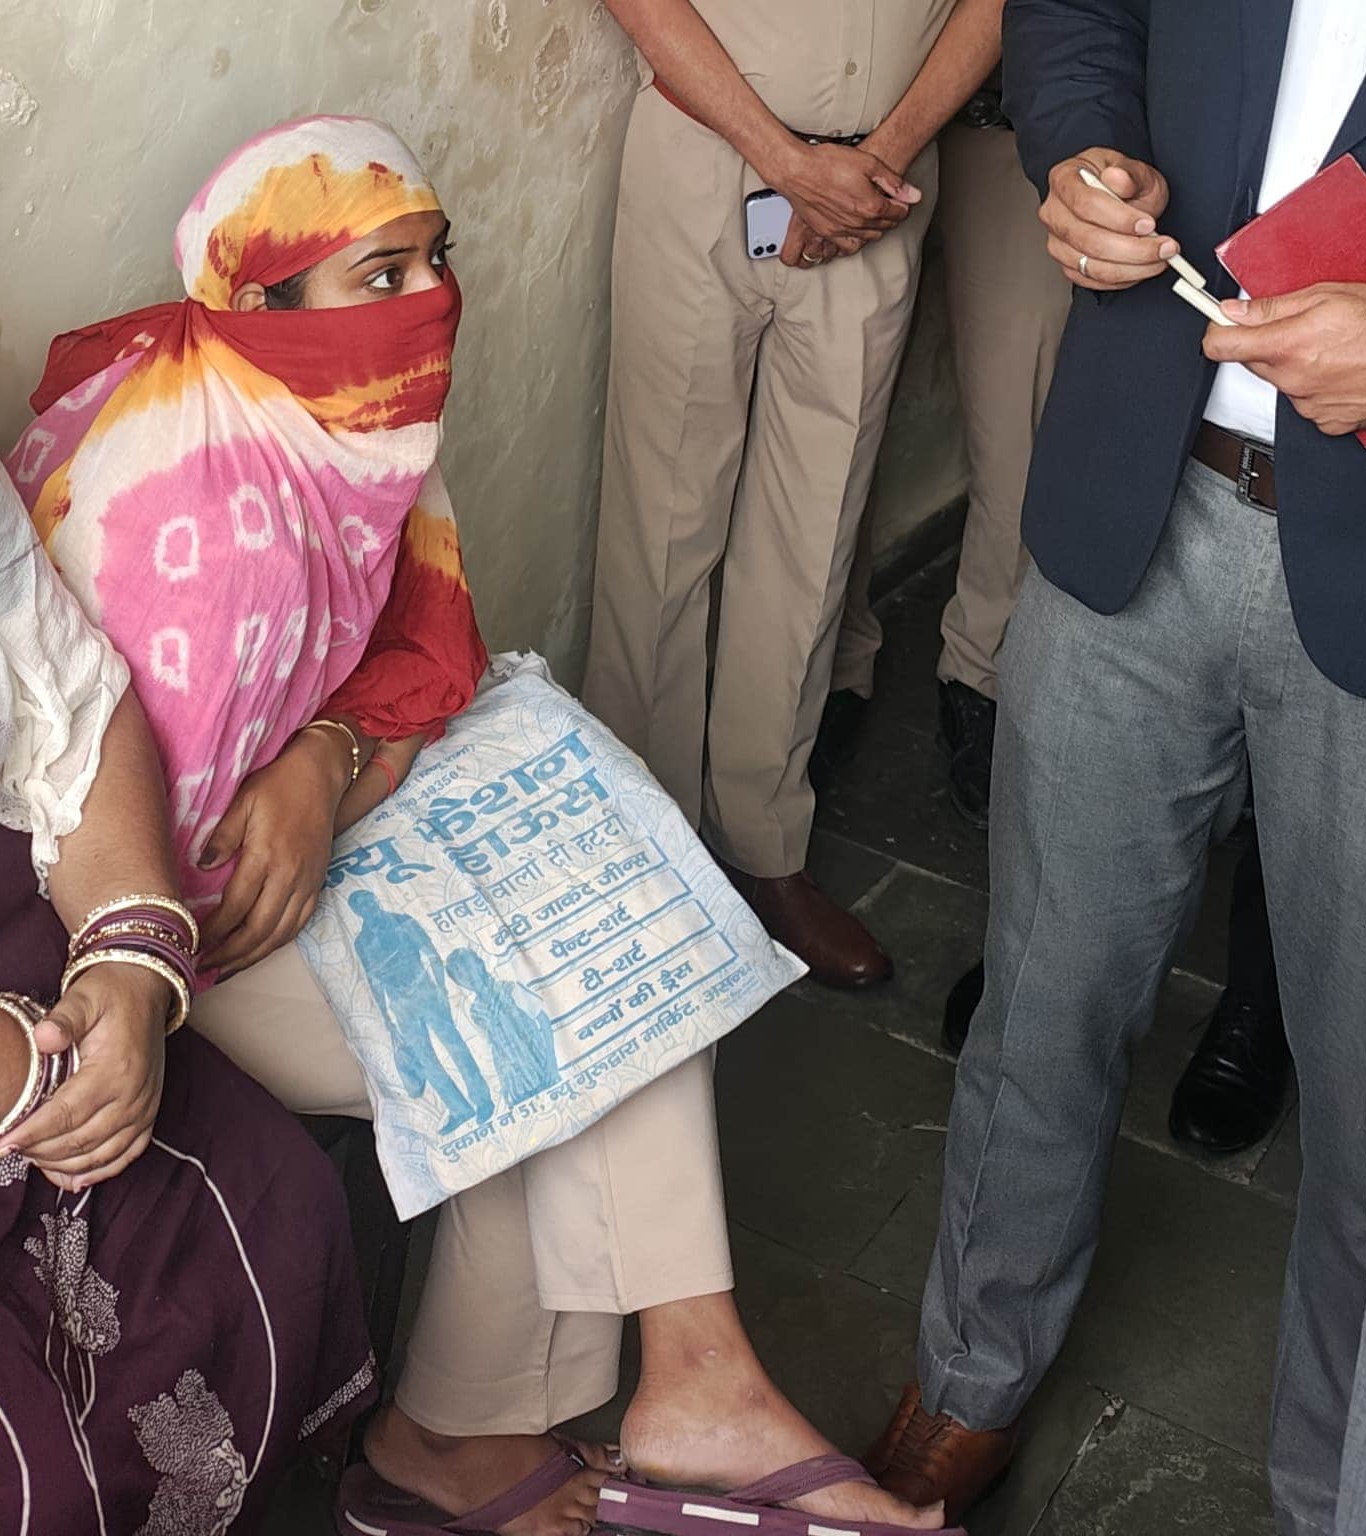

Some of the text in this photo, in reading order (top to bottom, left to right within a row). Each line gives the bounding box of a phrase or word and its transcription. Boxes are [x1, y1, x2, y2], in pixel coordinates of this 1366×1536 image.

[413, 728, 592, 843] फैशन
[443, 766, 610, 876] हाऊस
[489, 852, 544, 900] वालों
[626, 982, 657, 1009] की
[438, 1120, 497, 1164] दुकान
